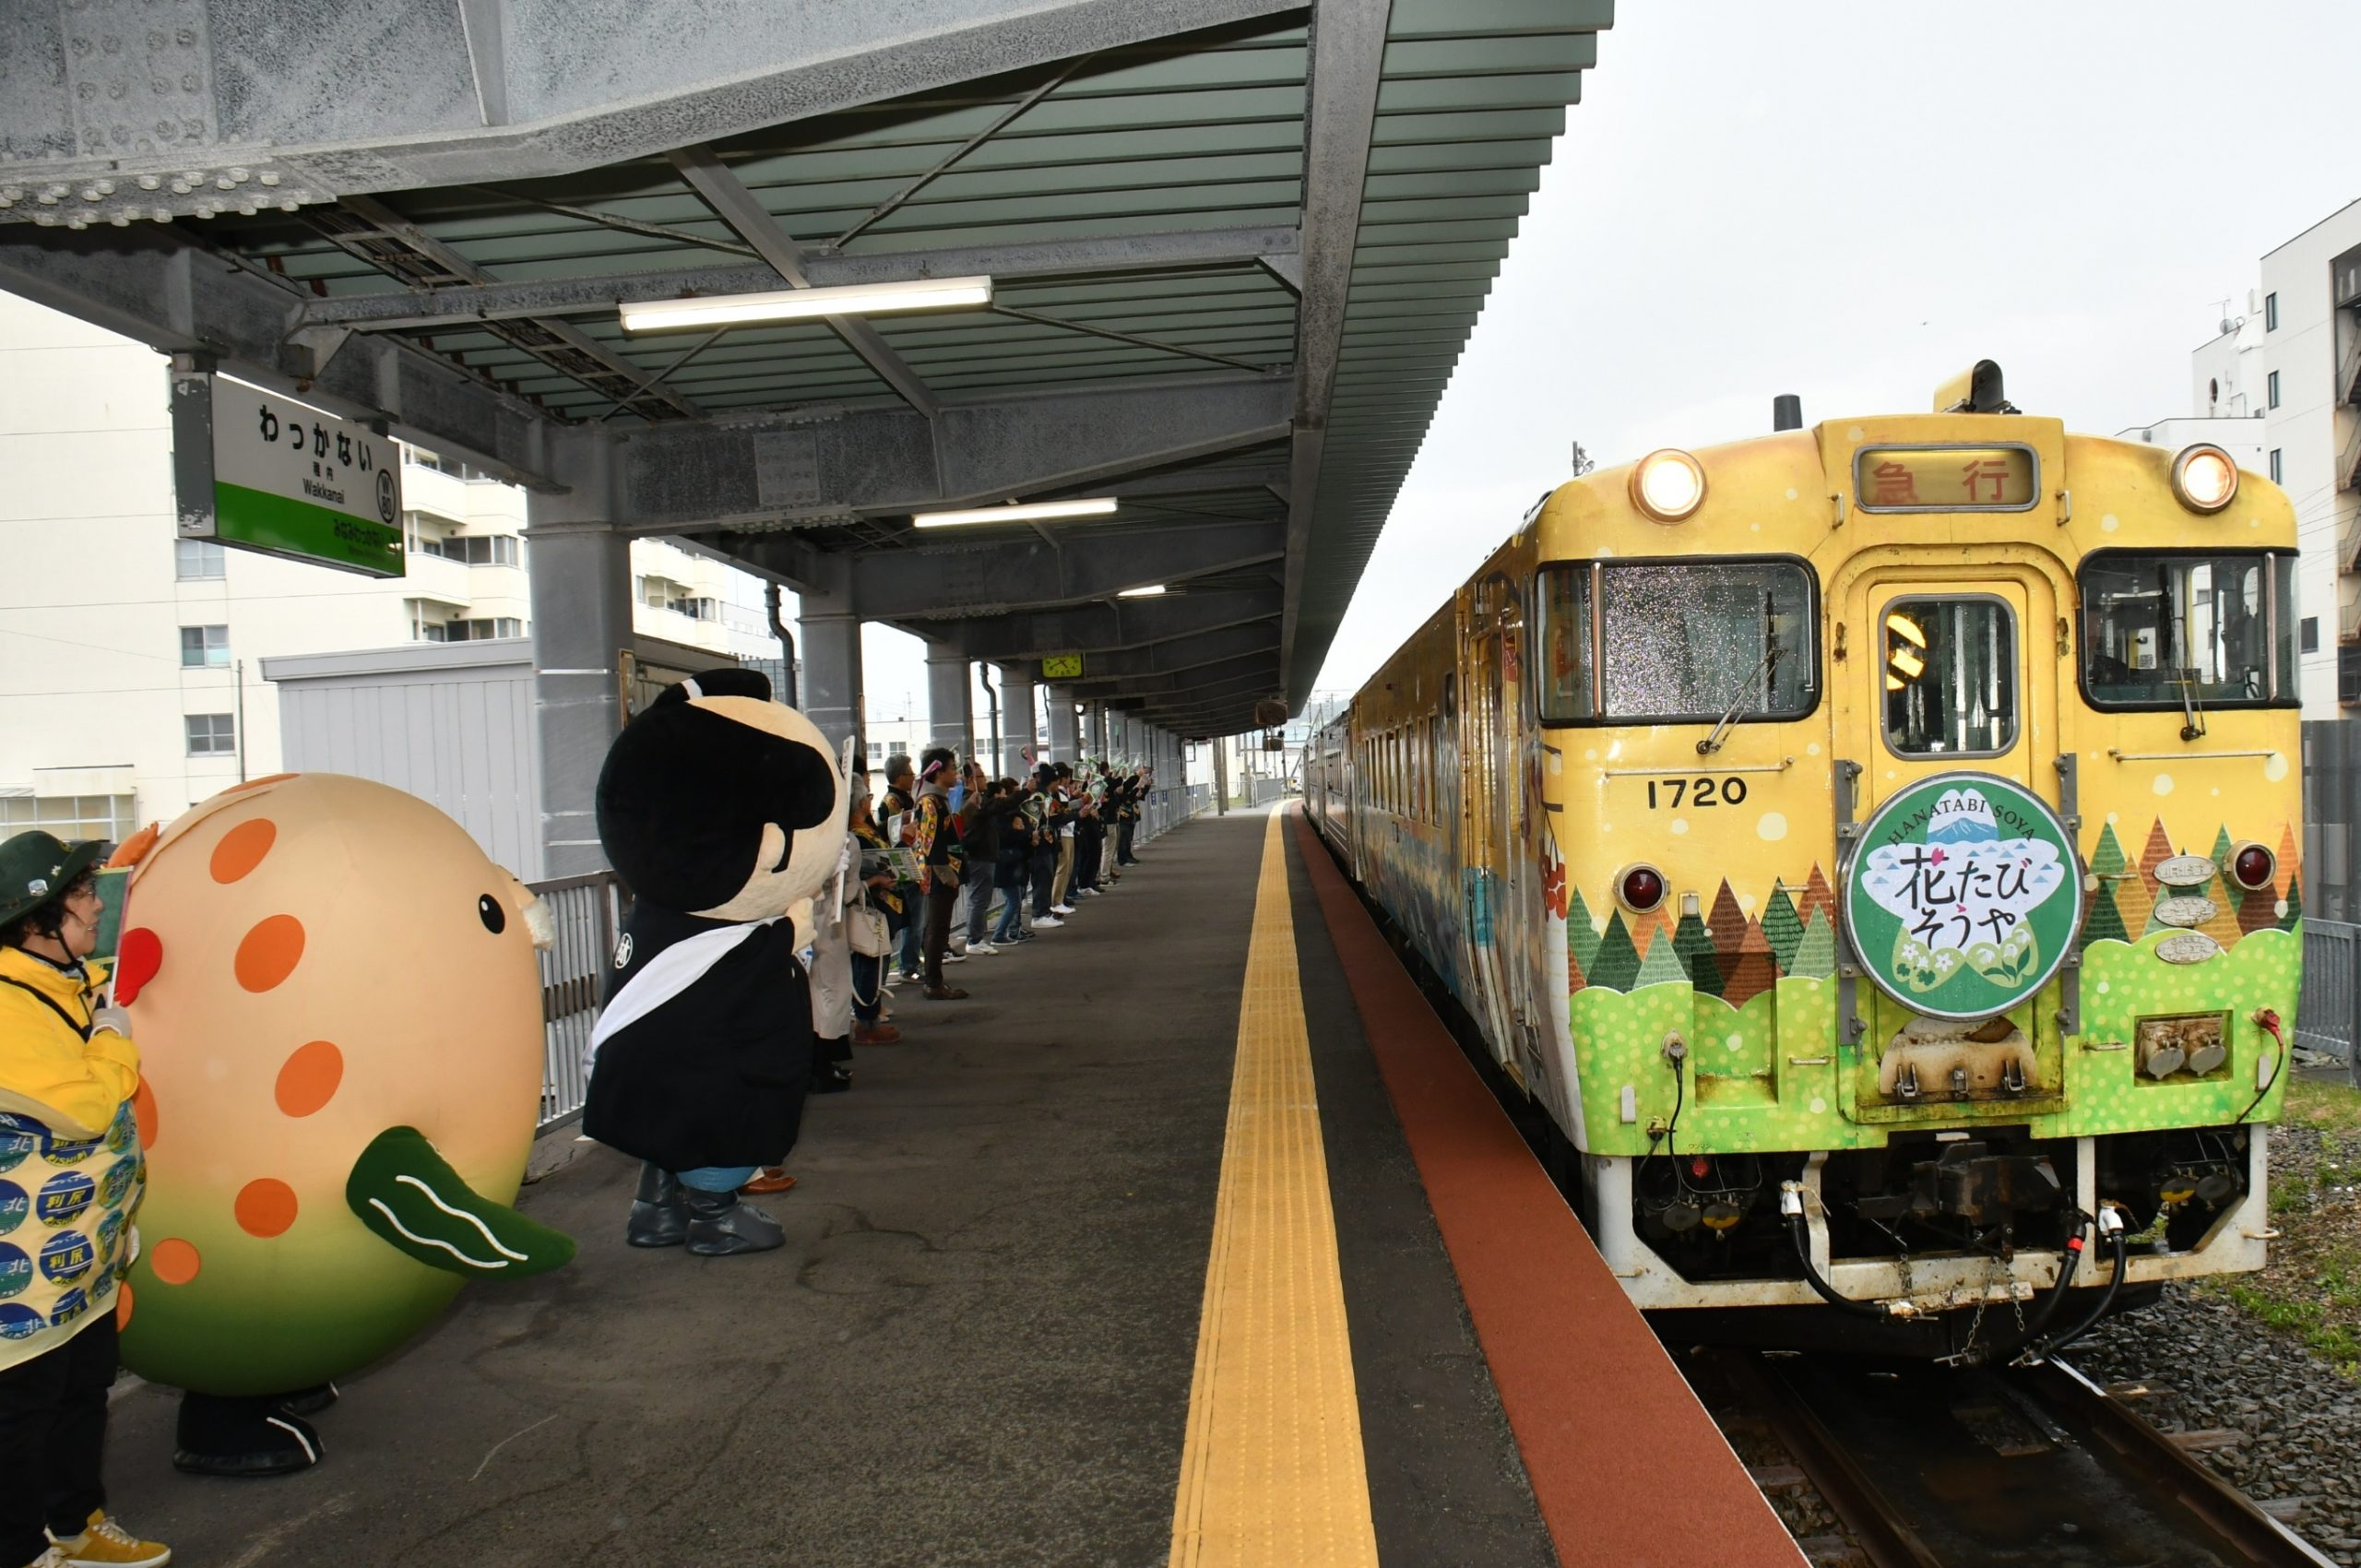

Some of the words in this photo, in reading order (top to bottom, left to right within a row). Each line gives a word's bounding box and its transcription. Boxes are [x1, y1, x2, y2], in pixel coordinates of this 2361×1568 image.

[259, 404, 373, 471] わっかない
[313, 461, 334, 481] 稚内
[380, 473, 389, 494] W
[1872, 459, 2010, 505] 急行
[303, 478, 345, 505] Wakkanai
[381, 494, 392, 516] 80
[1647, 776, 1747, 809] 1720
[1887, 798, 1987, 847] HANATABI
[1992, 804, 2035, 841] SOYA
[1894, 847, 2033, 910] 花たび
[1911, 903, 2016, 950] そうや
[49, 1247, 84, 1269] 利尻
